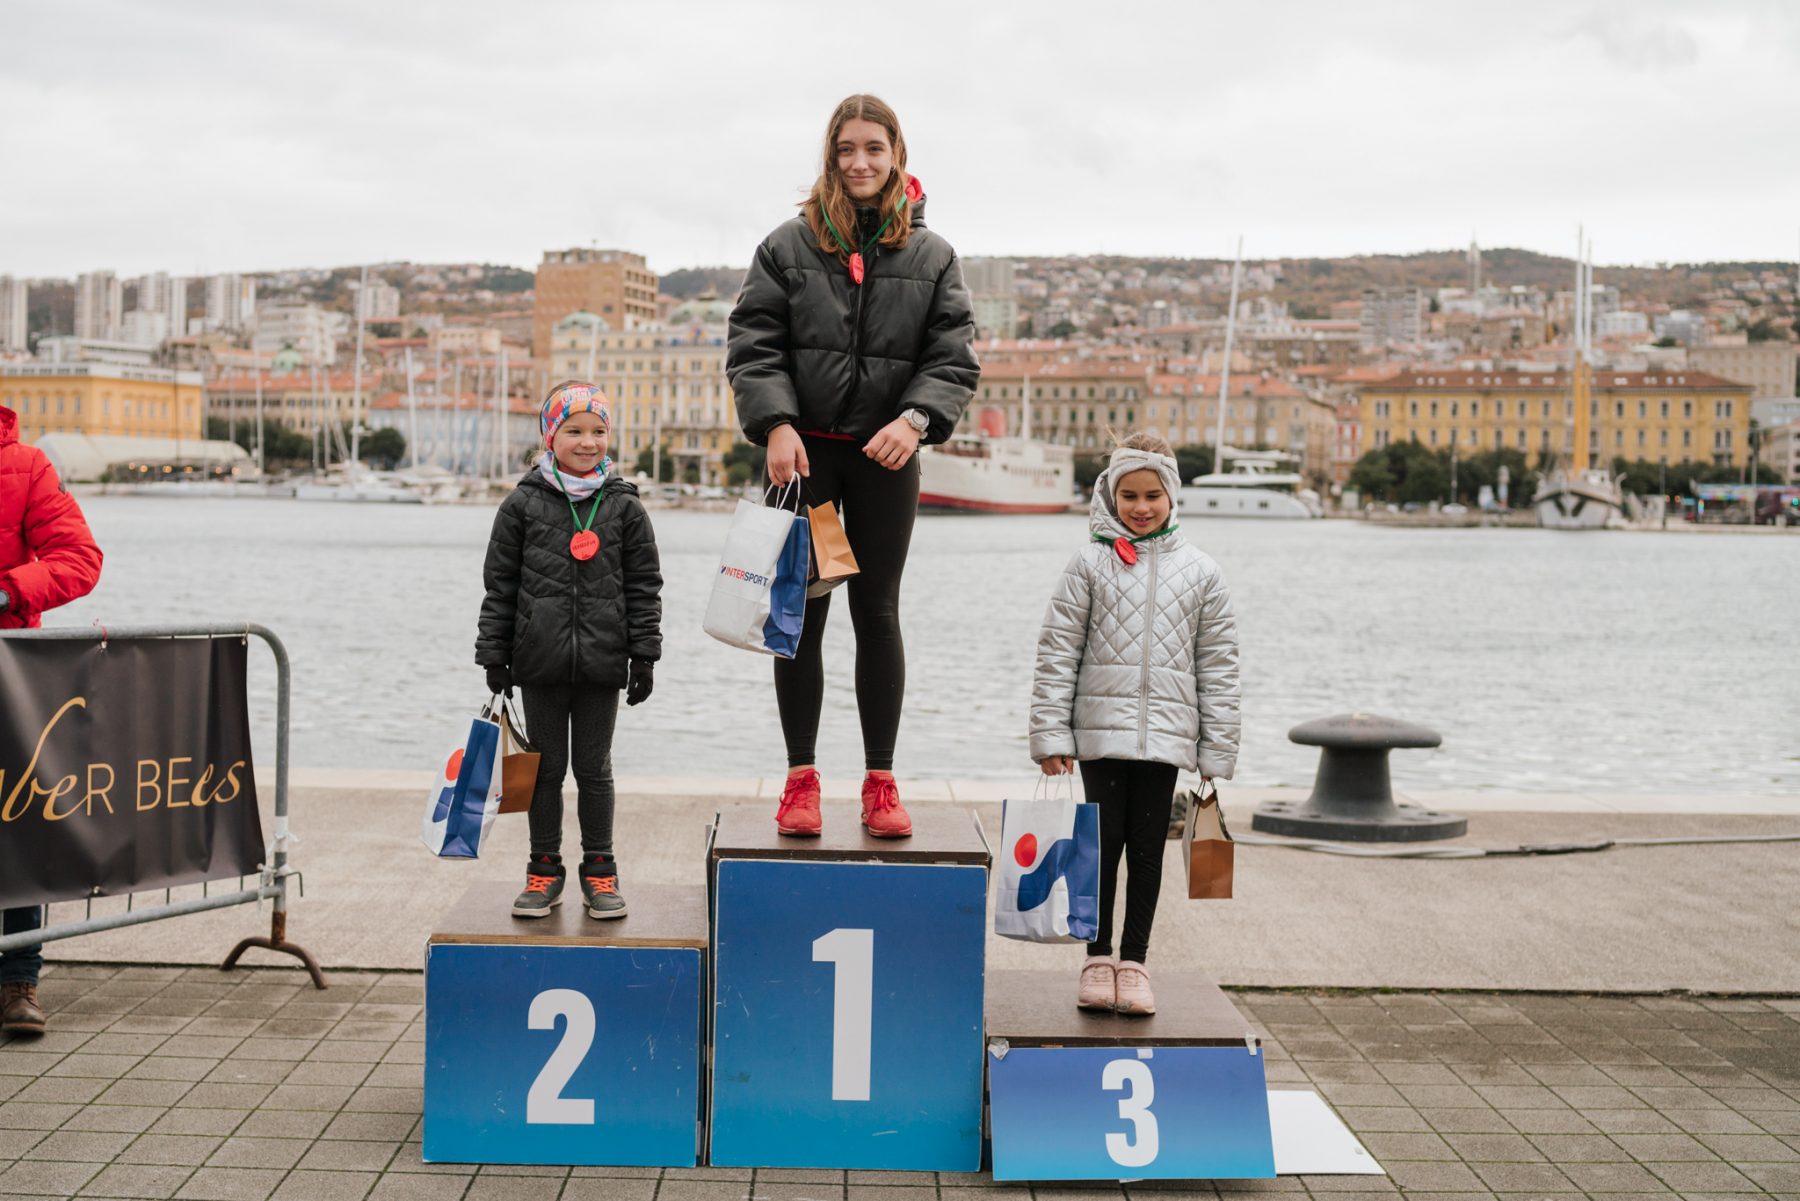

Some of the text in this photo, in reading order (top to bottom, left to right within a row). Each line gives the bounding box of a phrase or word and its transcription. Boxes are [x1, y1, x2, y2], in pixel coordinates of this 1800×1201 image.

[724, 566, 769, 587] INTERSPORT
[0, 696, 115, 822] beR
[526, 988, 596, 1125] 2
[811, 927, 874, 1101] 1
[1101, 1058, 1160, 1168] 3
